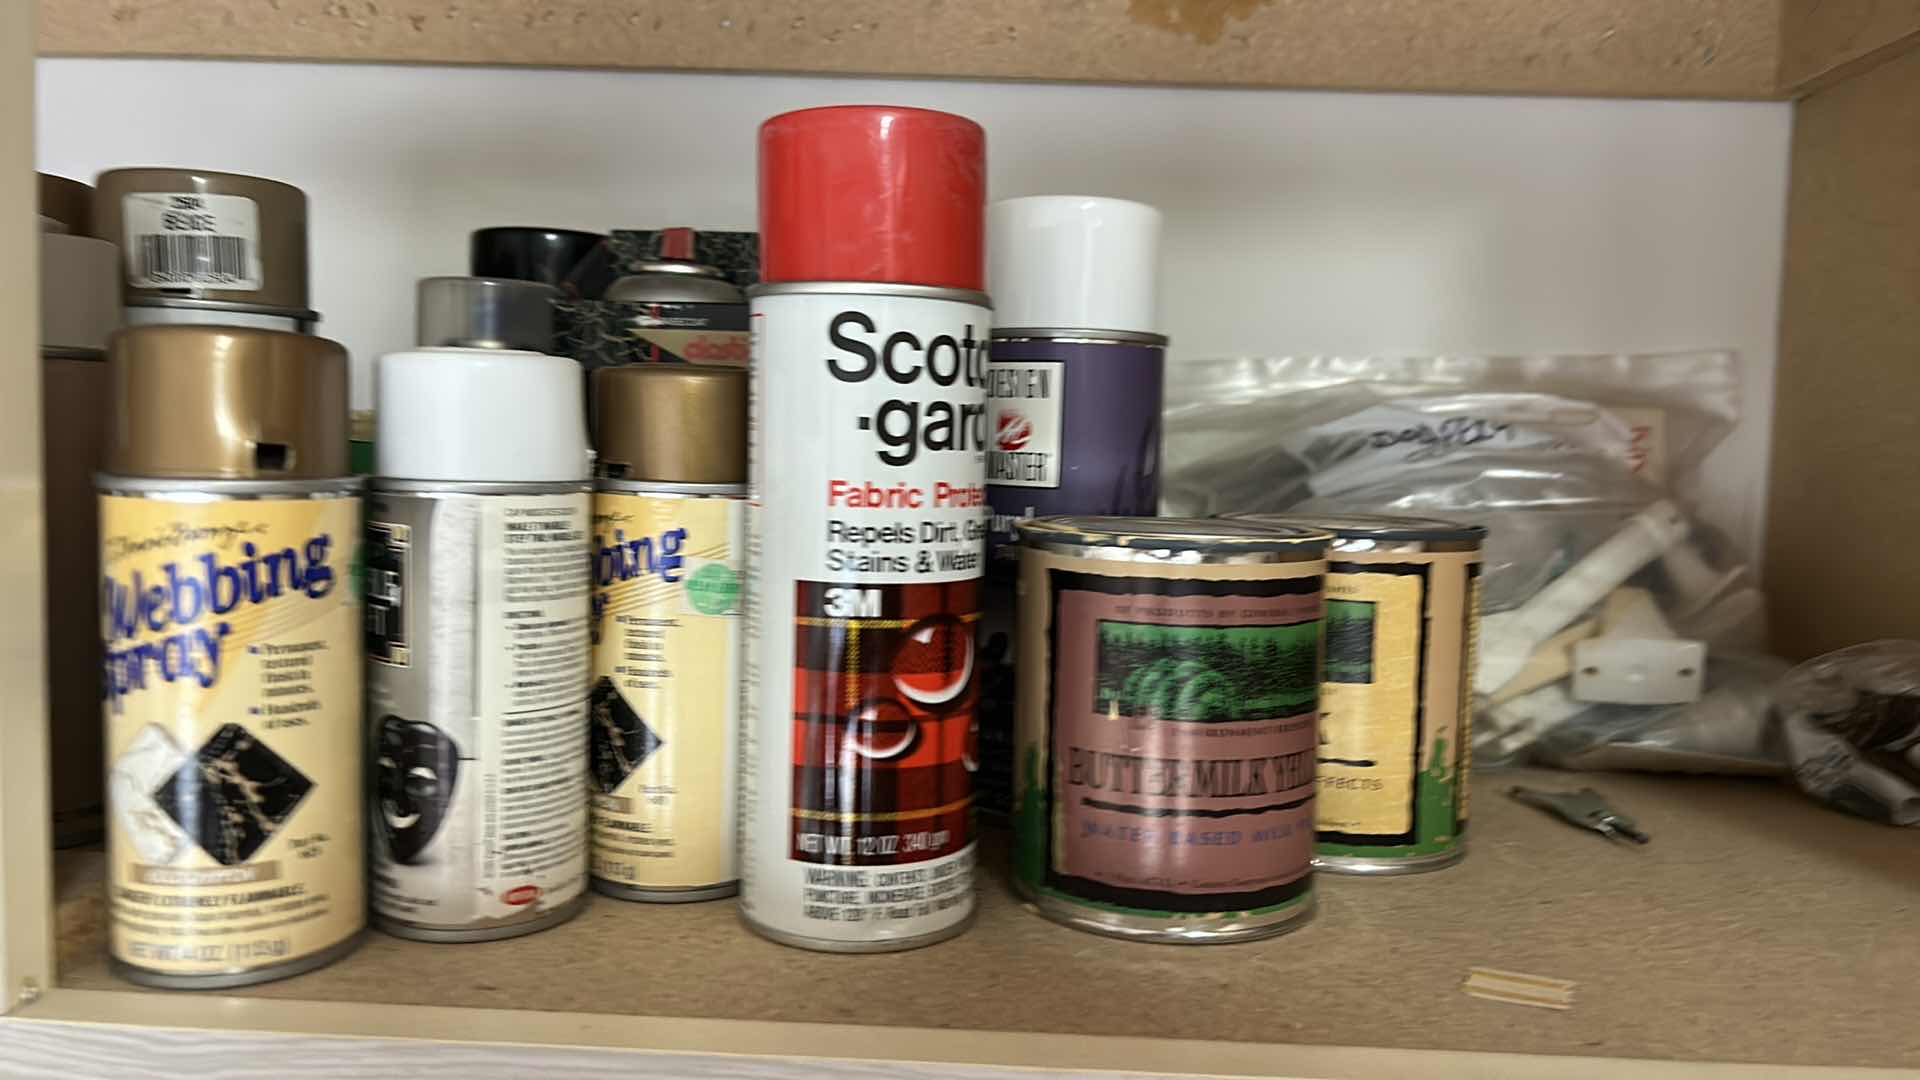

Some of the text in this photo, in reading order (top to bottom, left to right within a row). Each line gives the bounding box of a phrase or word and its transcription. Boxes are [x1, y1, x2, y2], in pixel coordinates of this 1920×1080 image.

[828, 479, 924, 509] Fabric
[827, 520, 915, 548] Repels
[826, 549, 909, 573] Stains
[914, 550, 934, 573] &
[104, 533, 335, 638] Webbing
[824, 587, 882, 617] 3M
[1069, 746, 1268, 798] BUTTERMILK
